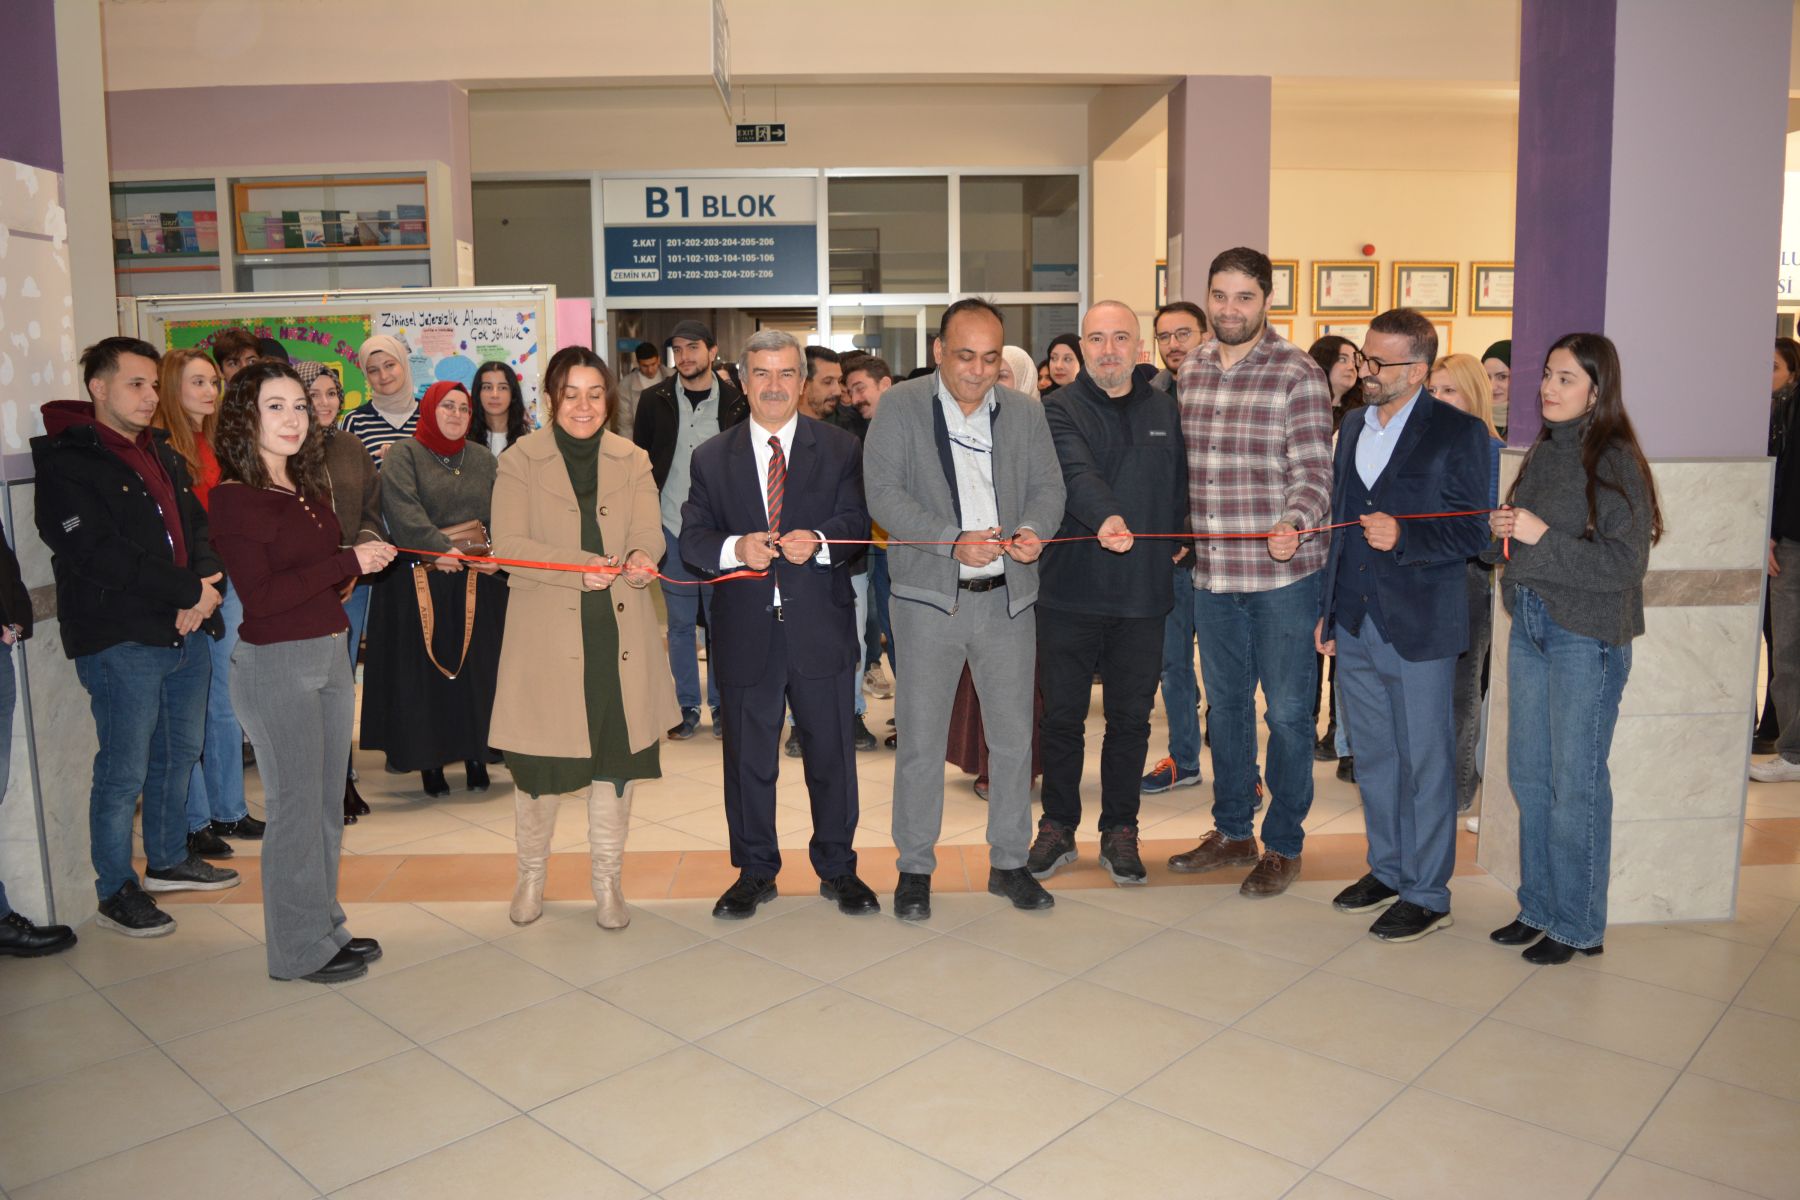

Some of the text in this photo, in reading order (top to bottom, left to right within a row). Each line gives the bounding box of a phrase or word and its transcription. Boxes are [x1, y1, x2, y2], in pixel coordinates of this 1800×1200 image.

[645, 186, 776, 218] B1 BLOK
[632, 238, 775, 248] 2.KAT 201-202-203-204-205-206
[633, 254, 775, 264] 1.KAT 101-102-103-104-105-106
[613, 270, 774, 280] ZEMİN KAT Z01-Z02-Z03-Z04-Z05-Z06
[381, 311, 417, 328] Zihinsel
[420, 308, 459, 328] Yetersizlik
[279, 324, 334, 347] HAZİNE
[470, 327, 489, 342] Çok
